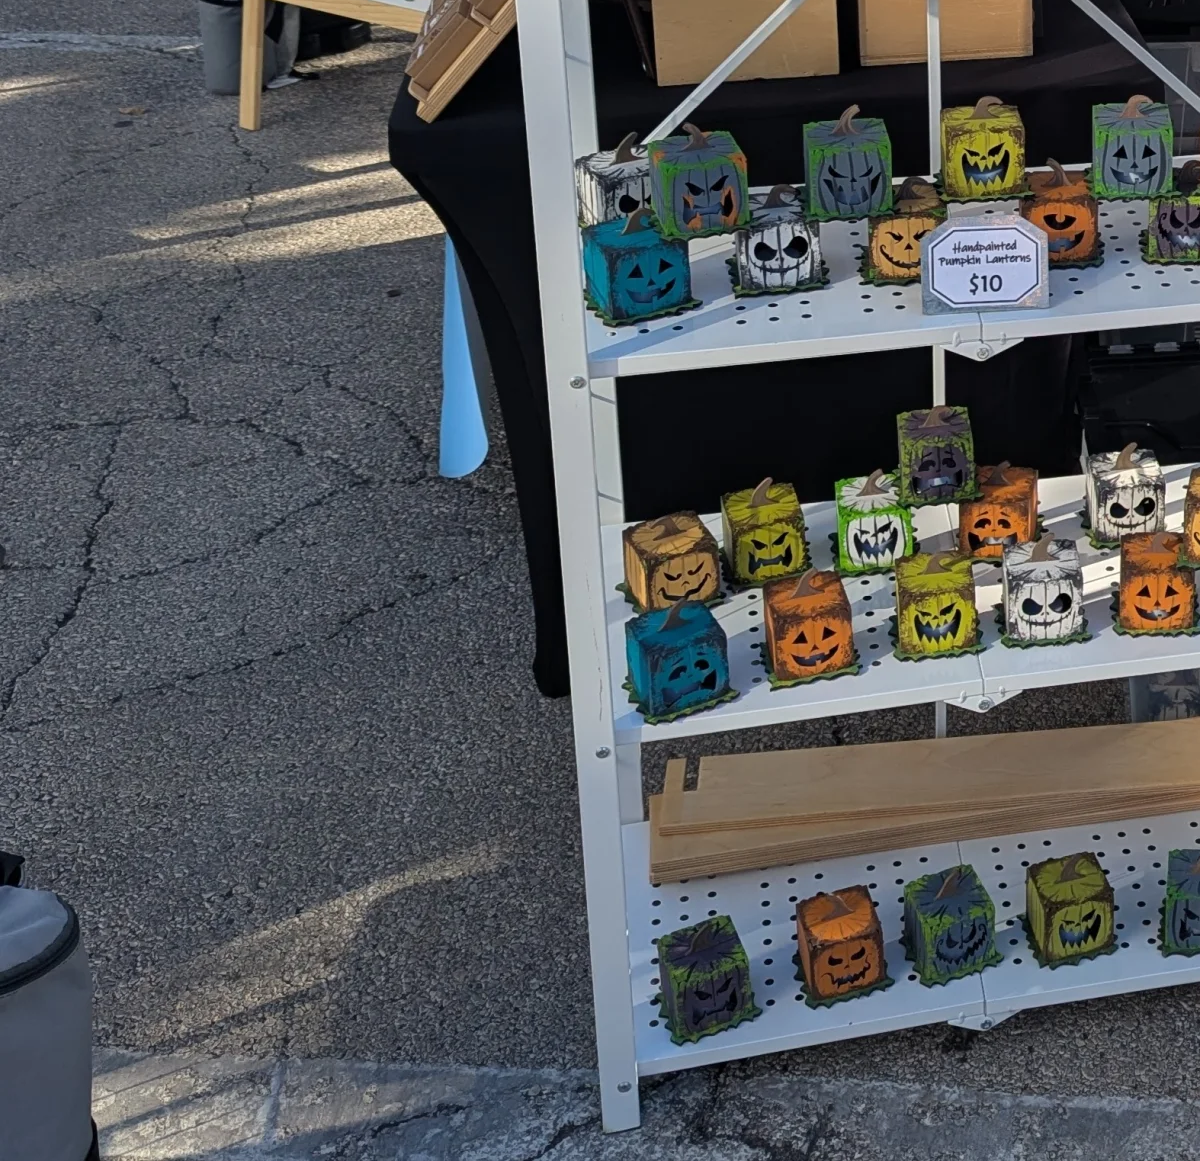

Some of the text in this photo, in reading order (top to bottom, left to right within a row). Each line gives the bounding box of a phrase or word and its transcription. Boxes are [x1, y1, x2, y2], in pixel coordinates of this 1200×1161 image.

[952, 240, 1017, 254] Handpainted
[938, 253, 1032, 267] Pumpkin Lanterns
[969, 273, 1003, 295] $10
